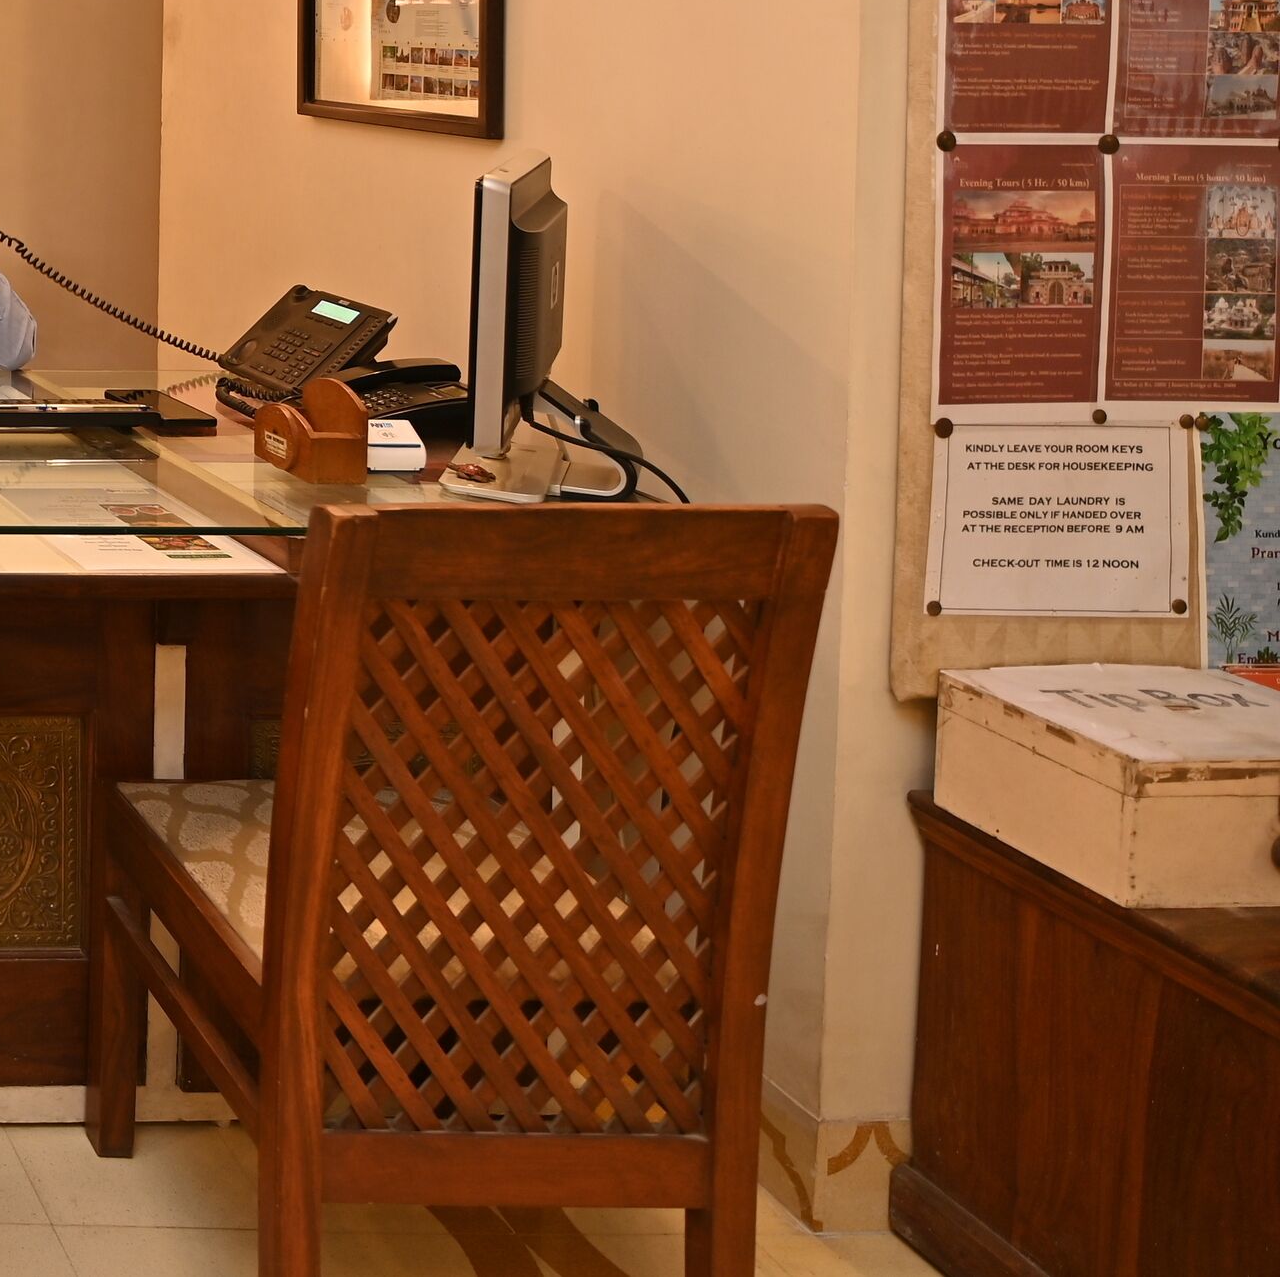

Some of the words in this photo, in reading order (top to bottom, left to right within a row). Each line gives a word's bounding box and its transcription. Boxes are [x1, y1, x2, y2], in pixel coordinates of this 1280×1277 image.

[1136, 173, 1170, 183] Morning
[1172, 173, 1195, 182] Tours
[960, 178, 993, 189] Evening
[995, 178, 1020, 187] Tours
[1034, 178, 1049, 187] Hr.
[965, 444, 1005, 453] KINDLY
[1007, 444, 1042, 453] LEAVE
[1044, 444, 1073, 453] YOUR
[1076, 444, 1109, 453] ROOM
[1112, 444, 1143, 454] KEYS
[967, 462, 982, 470] AT
[984, 462, 1005, 470] THE
[1007, 462, 1036, 470] DESK
[1038, 462, 1060, 470] FOR
[1062, 462, 1154, 472] HOUSEKEEPING
[992, 497, 1024, 505] SAME
[1029, 497, 1052, 505] DAY
[1057, 497, 1110, 505] LAUNDRY
[1115, 497, 1126, 505] IS
[963, 510, 1017, 519] POSSIBLE
[1019, 510, 1048, 519] ONLY
[1050, 510, 1060, 519] IF
[1062, 510, 1107, 519] HANDED
[1109, 510, 1141, 519] OVER
[961, 524, 977, 533] AT
[979, 524, 1001, 533] THE
[1003, 524, 1064, 533] RECEPTION
[1066, 524, 1110, 533] BEFORE
[1115, 524, 1122, 533] 9
[1125, 524, 1144, 533] AM
[972, 559, 1040, 568] CHECK-OUT
[1045, 559, 1070, 568] TIME
[1072, 559, 1082, 568] IS
[1086, 559, 1100, 568] 12
[1102, 559, 1139, 568] NOON
